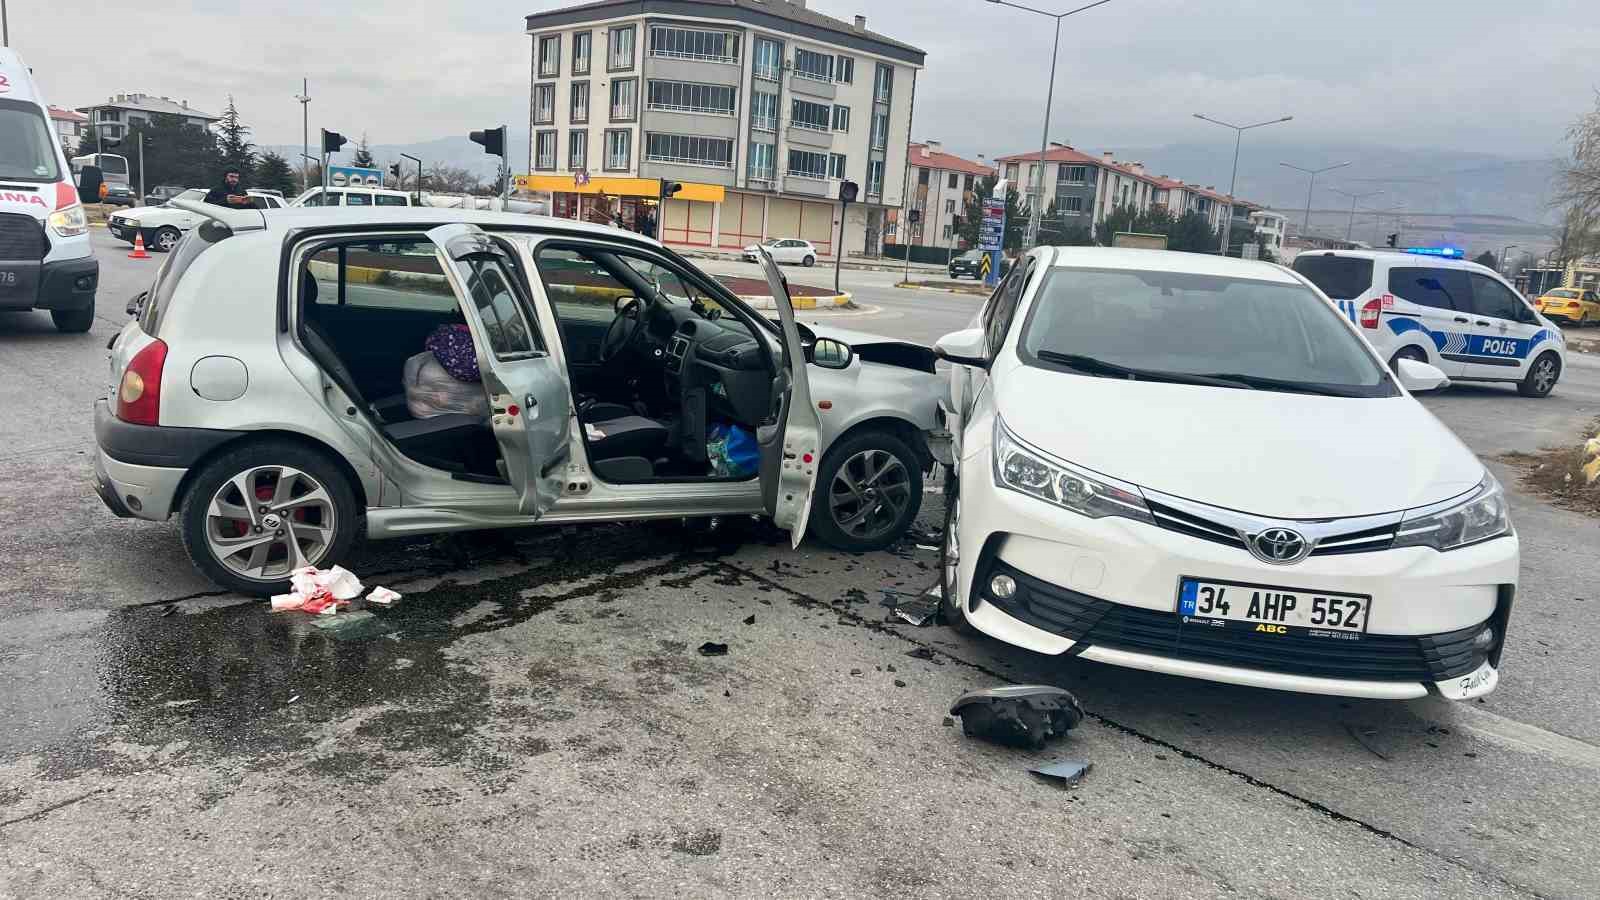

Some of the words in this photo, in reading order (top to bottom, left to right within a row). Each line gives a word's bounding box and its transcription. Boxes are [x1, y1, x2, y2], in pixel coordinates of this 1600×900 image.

[1183, 600, 1195, 609] TR
[1199, 587, 1231, 616] 34
[1246, 591, 1297, 622] AHP
[1310, 597, 1362, 628] 552
[1255, 623, 1288, 634] ABC
